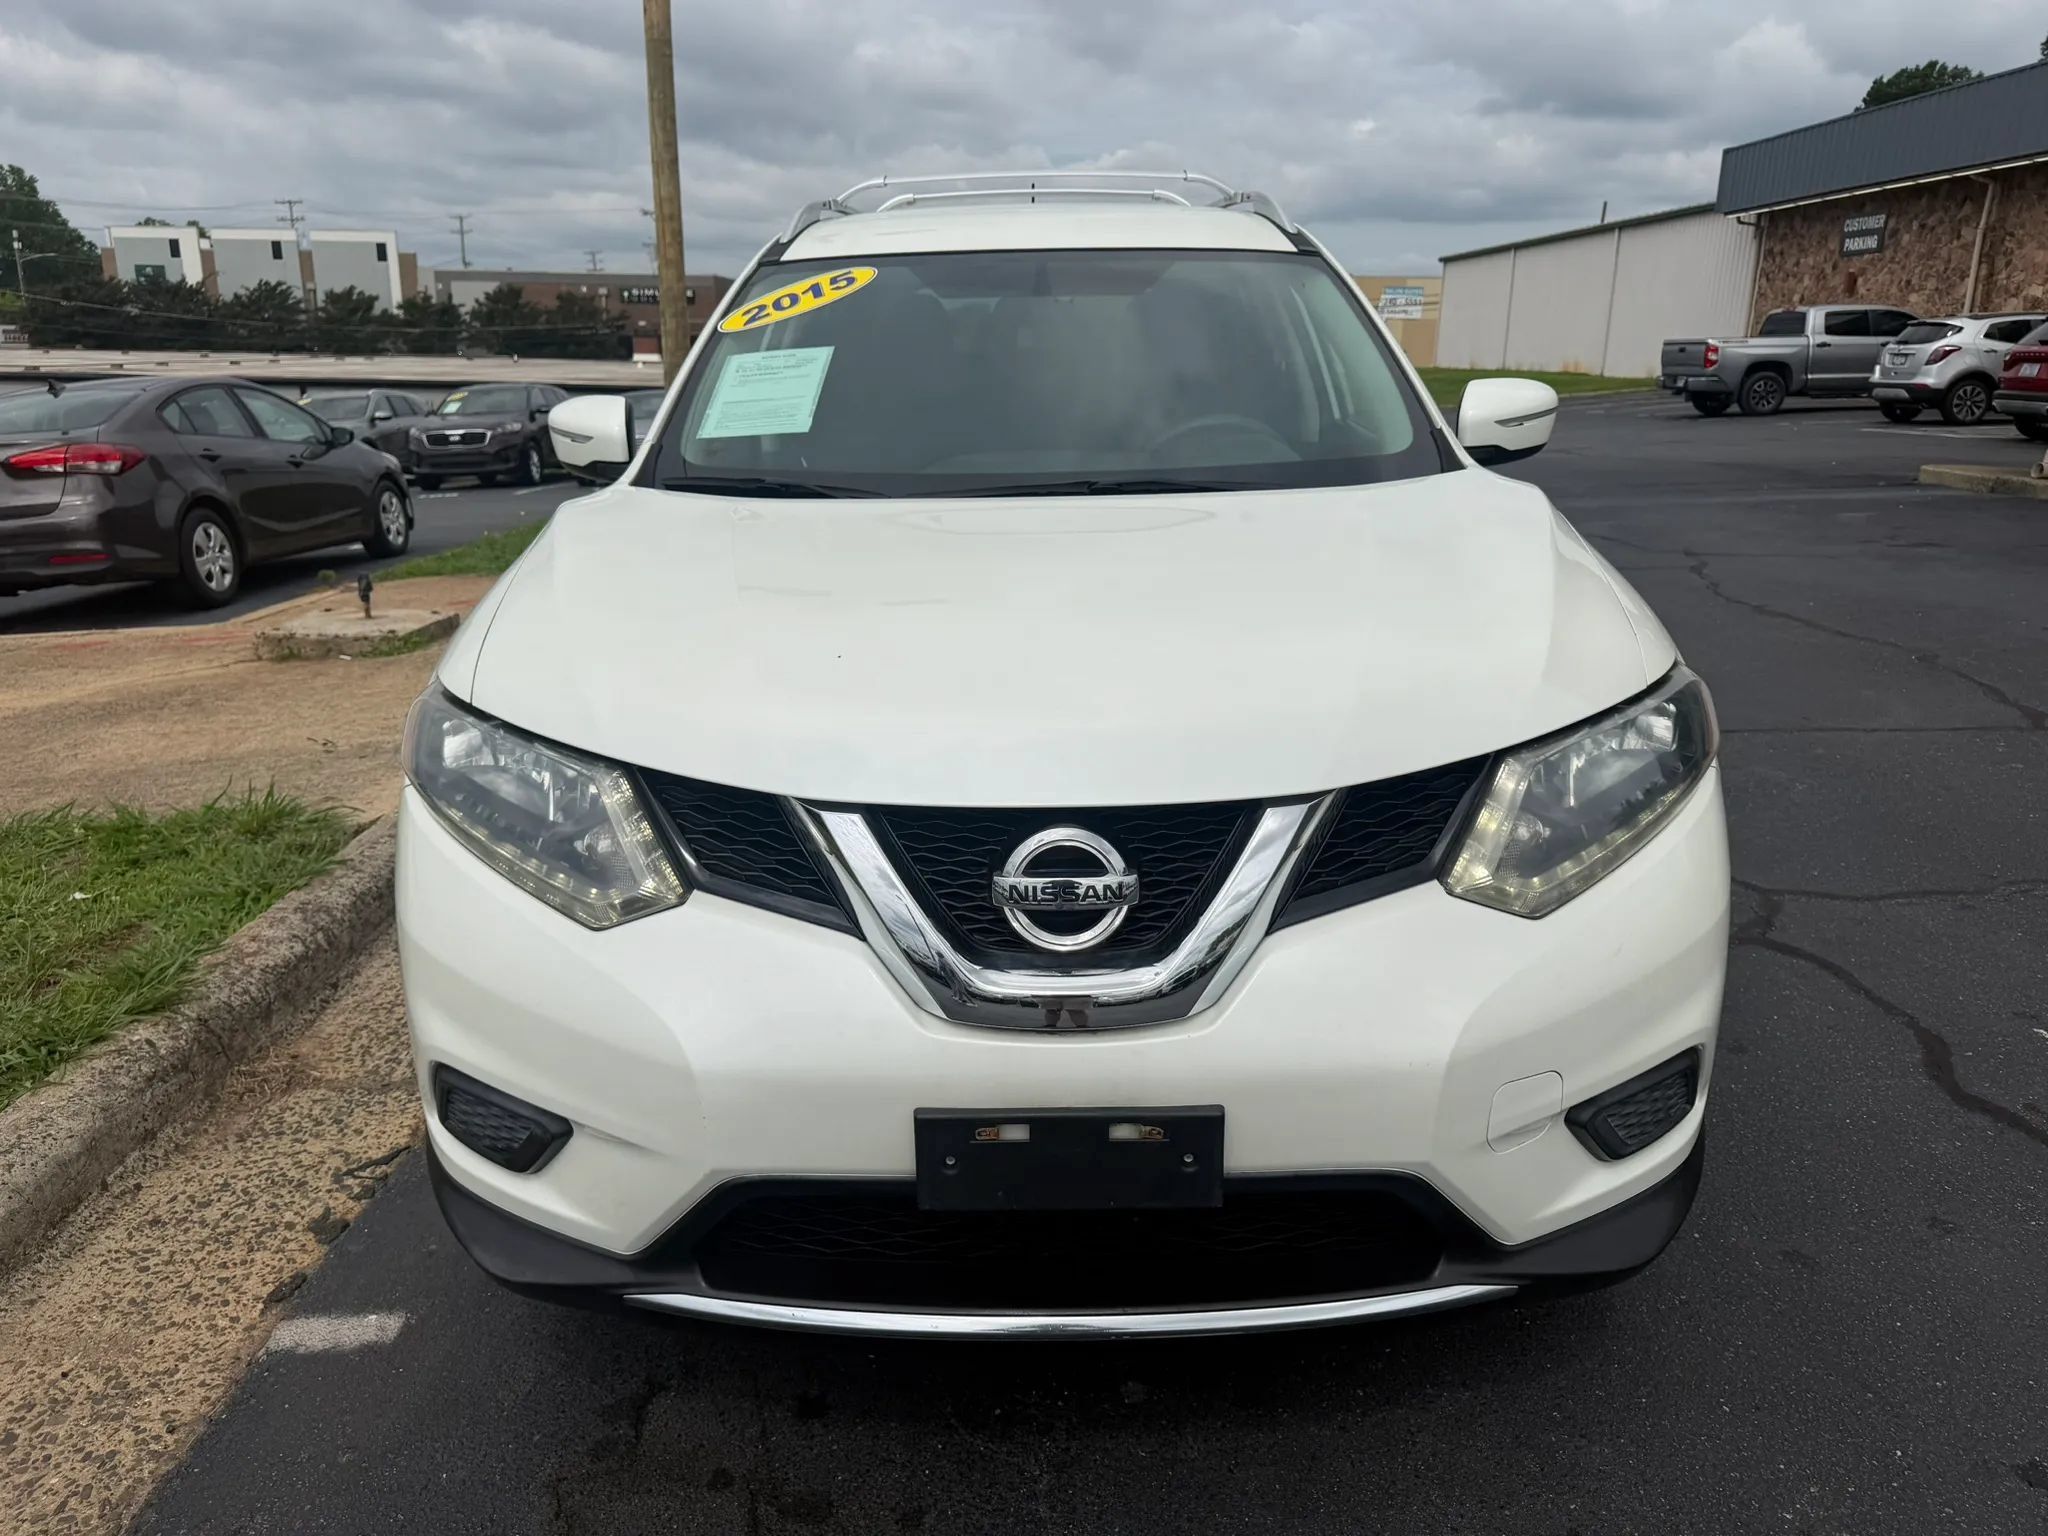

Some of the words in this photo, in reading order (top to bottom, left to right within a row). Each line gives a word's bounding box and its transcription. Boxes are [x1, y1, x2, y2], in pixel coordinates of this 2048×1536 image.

[1843, 214, 1887, 232] CUSTOMER
[1843, 235, 1878, 252] PARKING
[740, 271, 858, 328] 2015
[1008, 883, 1124, 904] NISSAN
